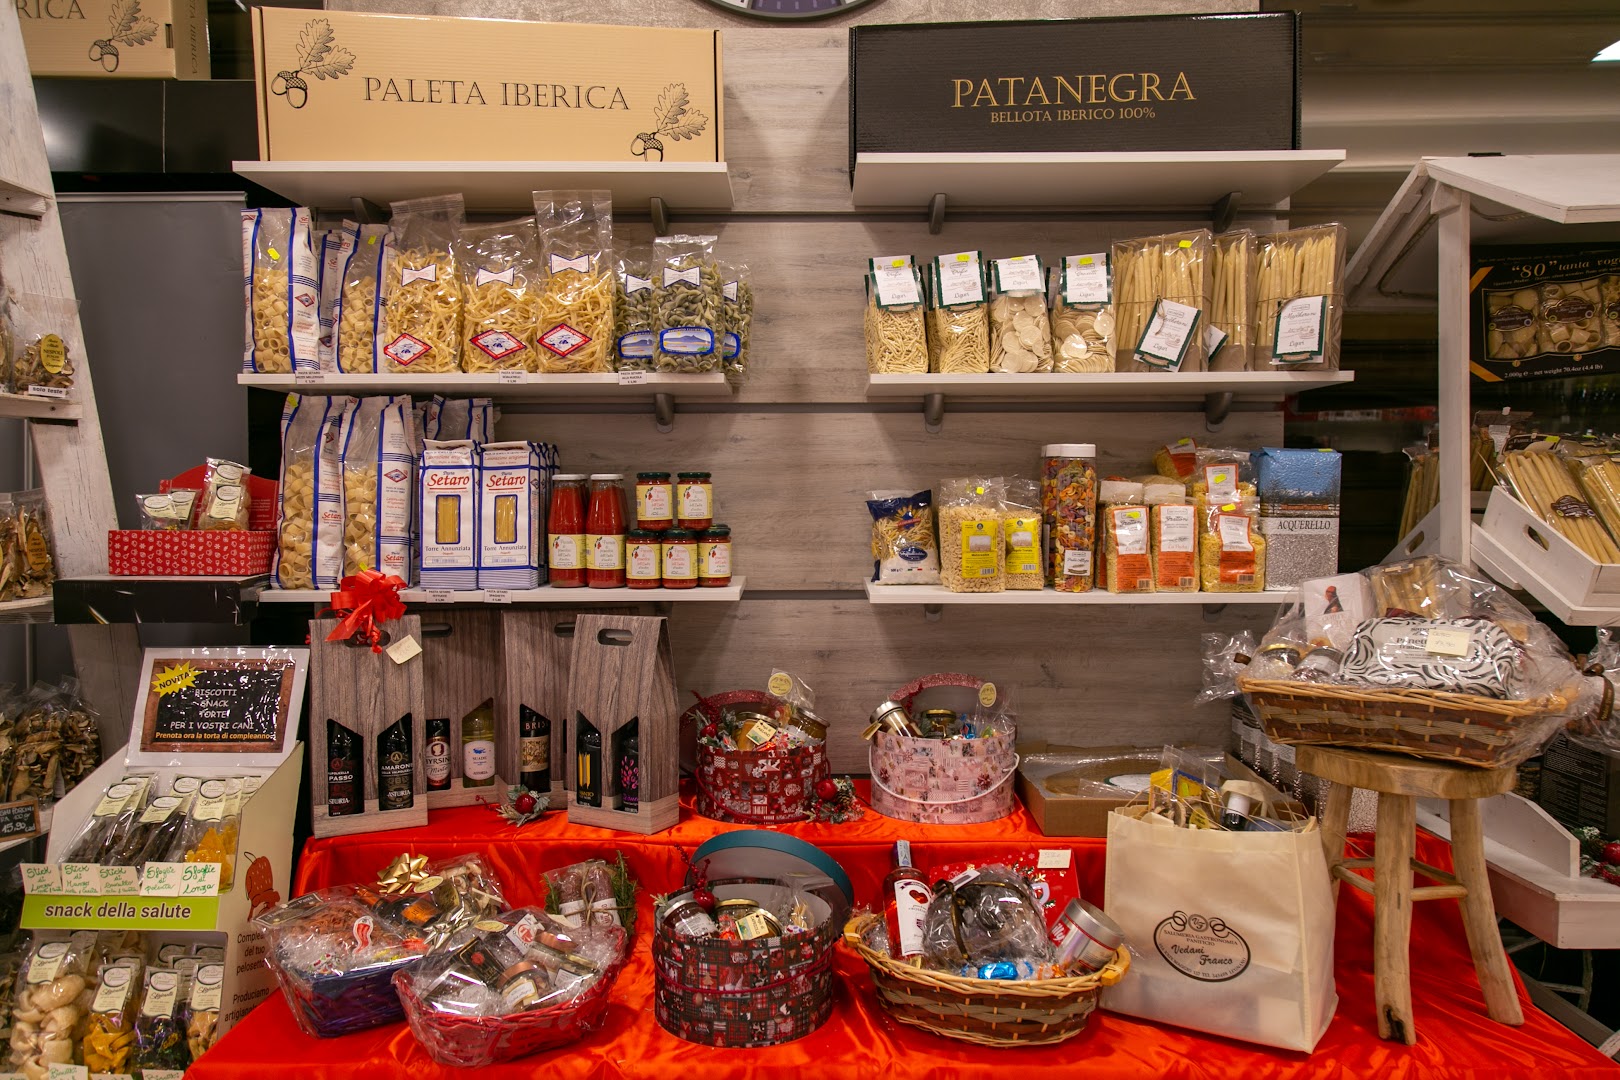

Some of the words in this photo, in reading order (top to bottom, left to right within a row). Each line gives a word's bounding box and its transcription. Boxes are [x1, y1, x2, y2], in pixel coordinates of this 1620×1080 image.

[363, 76, 488, 106] PALETA
[501, 81, 631, 111] IBERICA
[950, 71, 1197, 108] PATANEGRA
[990, 109, 1053, 123] BELLOTA
[1056, 108, 1115, 121] IBERICO
[1119, 106, 1156, 119] 100%
[427, 473, 470, 487] Setaro
[486, 474, 526, 488] Setaro
[1277, 519, 1331, 532] ACQUERELLO
[195, 688, 238, 697] BISCOTTI
[170, 721, 186, 730] PER
[188, 721, 194, 729] I
[196, 721, 230, 730] VOSTRI
[232, 722, 255, 730] CANI
[155, 731, 183, 740] Prenota
[203, 732, 221, 740] torta
[229, 732, 270, 741] compleanno
[26, 866, 51, 879] Stick
[64, 864, 89, 875] Stick
[99, 867, 126, 879] Stick
[183, 883, 216, 894] Lonza
[45, 902, 92, 917] snack
[97, 902, 136, 918] della
[140, 902, 191, 918] salute
[1051, 922, 1066, 941] illy
[1163, 929, 1196, 939] SALUMERIA
[1195, 934, 1239, 946] GASTRONOMIA
[1186, 937, 1216, 947] PANIFICIO
[244, 947, 254, 957] del
[255, 945, 266, 955] tuo
[1170, 943, 1205, 955] Vedani
[1198, 954, 1233, 966] Franco
[232, 987, 270, 1005] Produciamo
